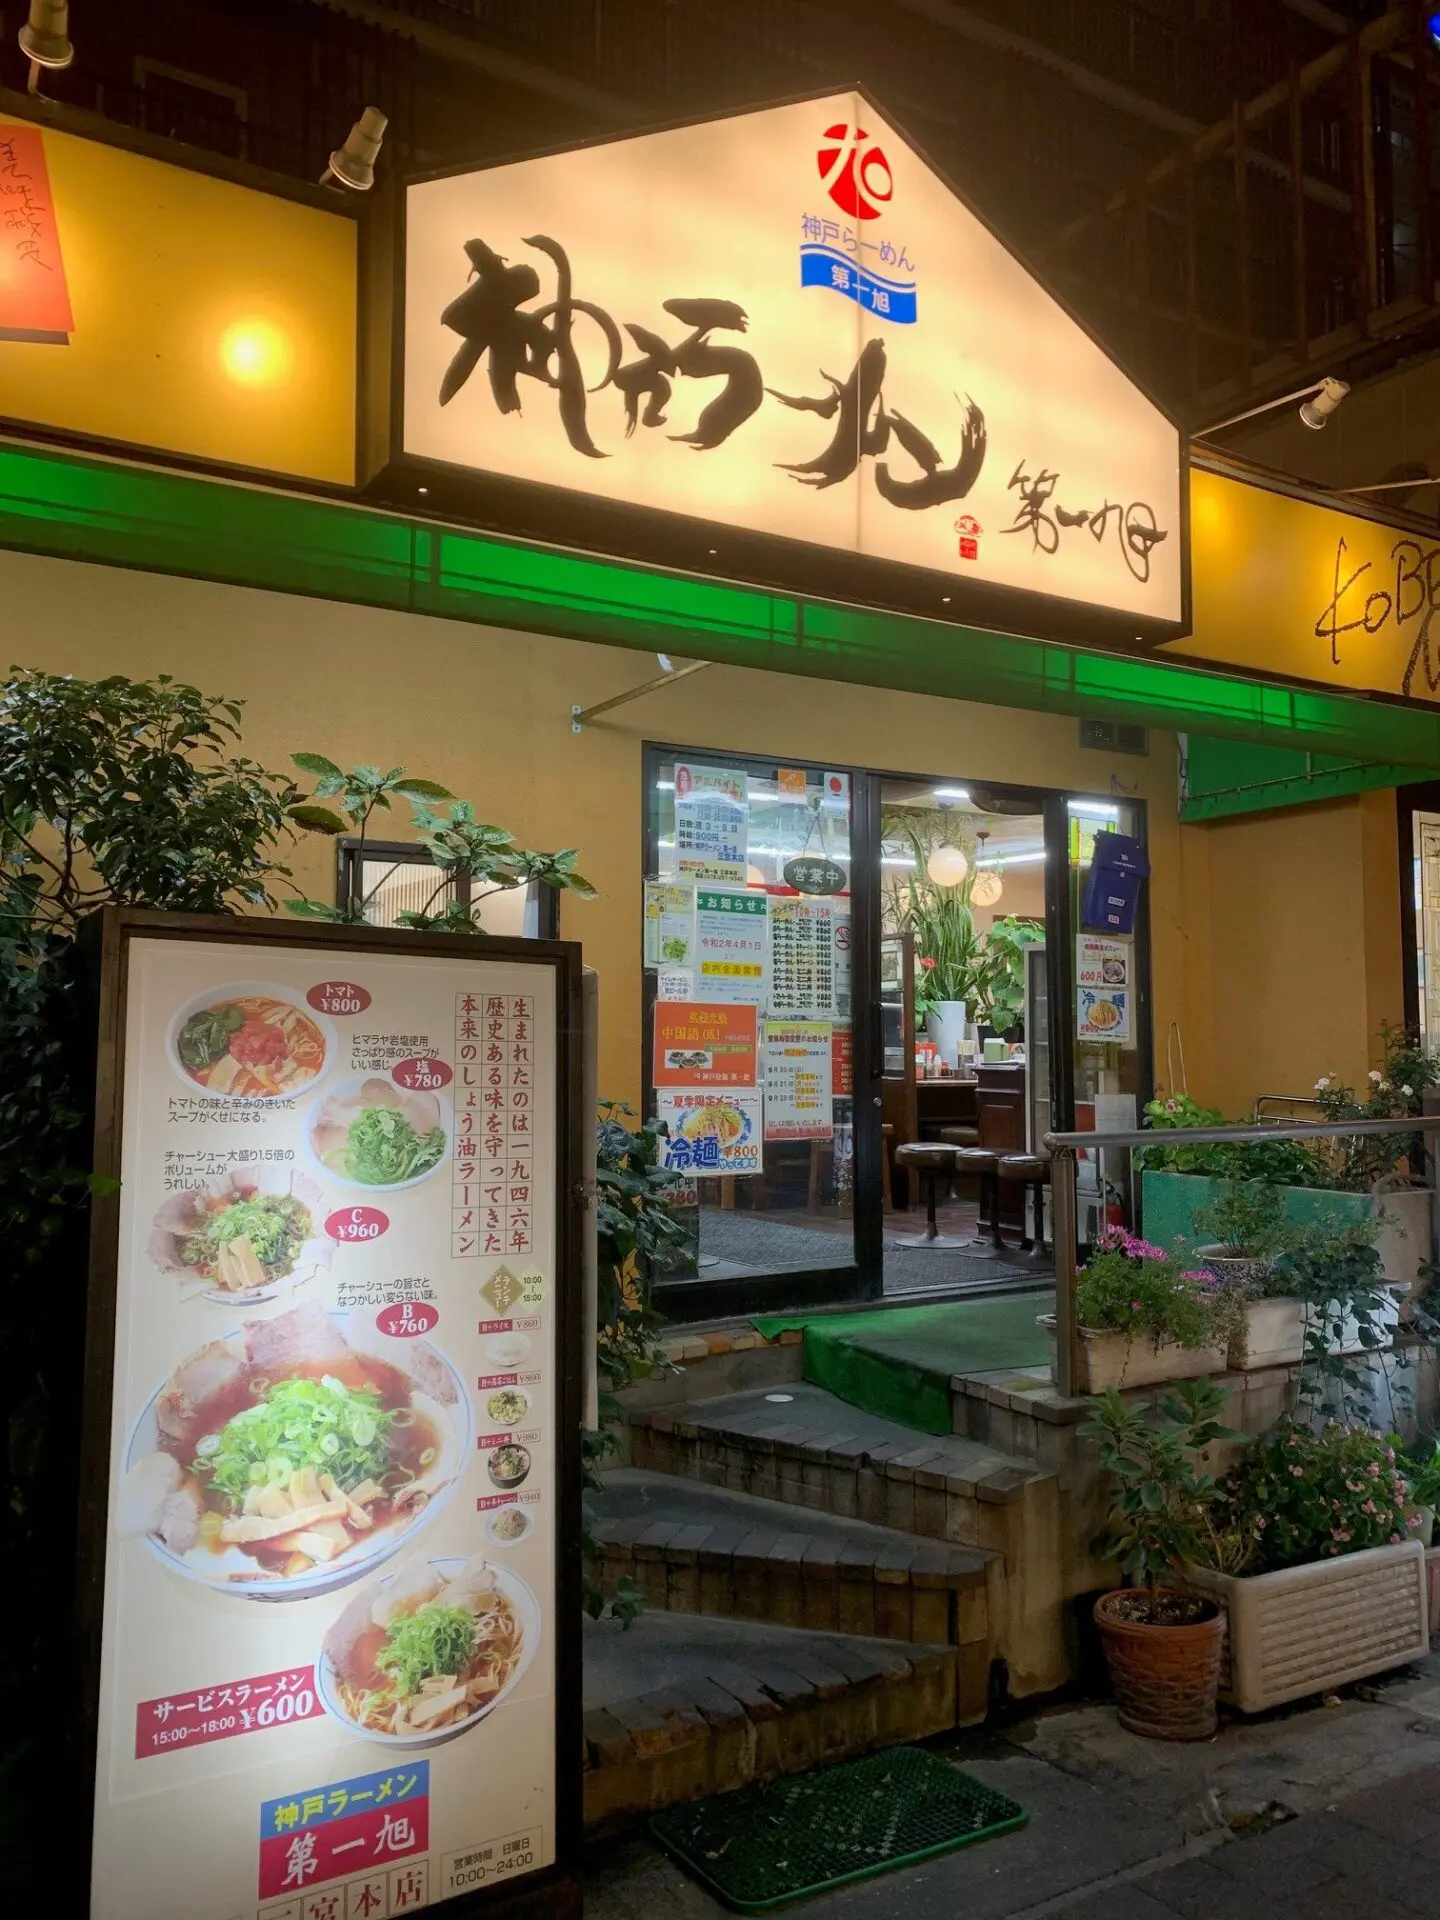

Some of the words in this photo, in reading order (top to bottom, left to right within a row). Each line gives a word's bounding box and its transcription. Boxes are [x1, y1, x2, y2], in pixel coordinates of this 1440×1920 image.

[802, 212, 915, 271] 神戸らーめん
[831, 264, 890, 313] 第一旭
[1000, 460, 1168, 584] 第一旭
[793, 865, 839, 885] 営業中
[707, 896, 756, 911] お知らせ
[702, 938, 762, 951] 令和2年4月1日
[324, 984, 355, 998] トマト
[320, 998, 361, 1013] ¥800
[352, 1034, 429, 1046] ヒマラヤ岩塩使用
[662, 1026, 699, 1040] 中国語
[352, 1046, 439, 1060] さっぱり感のスープが
[415, 1060, 431, 1074] 塩
[404, 1073, 443, 1088] ¥780
[168, 1097, 296, 1111] トマトの味と辛みのきいた
[168, 1111, 267, 1124] スープがくせになる。
[456, 994, 480, 1255] 本来のしょう油ラーメン
[483, 995, 505, 1253] 歴史ある味を守ってきた
[510, 996, 532, 1252] 生まれたのは一九四六年
[164, 1150, 295, 1162] チャーシュー大盛り1.5倍の
[665, 1136, 718, 1169] 冷麺
[723, 1145, 758, 1158] ¥800
[164, 1163, 227, 1176] ボリュームが
[719, 1157, 758, 1169] やってます
[164, 1177, 210, 1190] うれしい。
[352, 1208, 363, 1223] C
[338, 1222, 380, 1238] ¥960
[337, 1278, 431, 1292] チャーシューの旨さと
[523, 1276, 542, 1284] 10:00
[337, 1290, 438, 1306] なつかしい変らない味。
[503, 1276, 511, 1305] ランチ
[523, 1293, 542, 1302] 15:00
[402, 1305, 413, 1319] B
[388, 1318, 428, 1333] ¥760
[153, 1673, 307, 1724] サービスラーメン
[152, 1716, 236, 1746] 15:00~18:00
[239, 1690, 314, 1730] ¥600
[275, 1773, 418, 1832] 神戸ラーメン
[281, 1814, 416, 1886] 第一旭
[453, 1849, 493, 1869] 営業時間
[503, 1837, 531, 1856] 日曜日
[449, 1852, 533, 1890] 10:00~24:00
